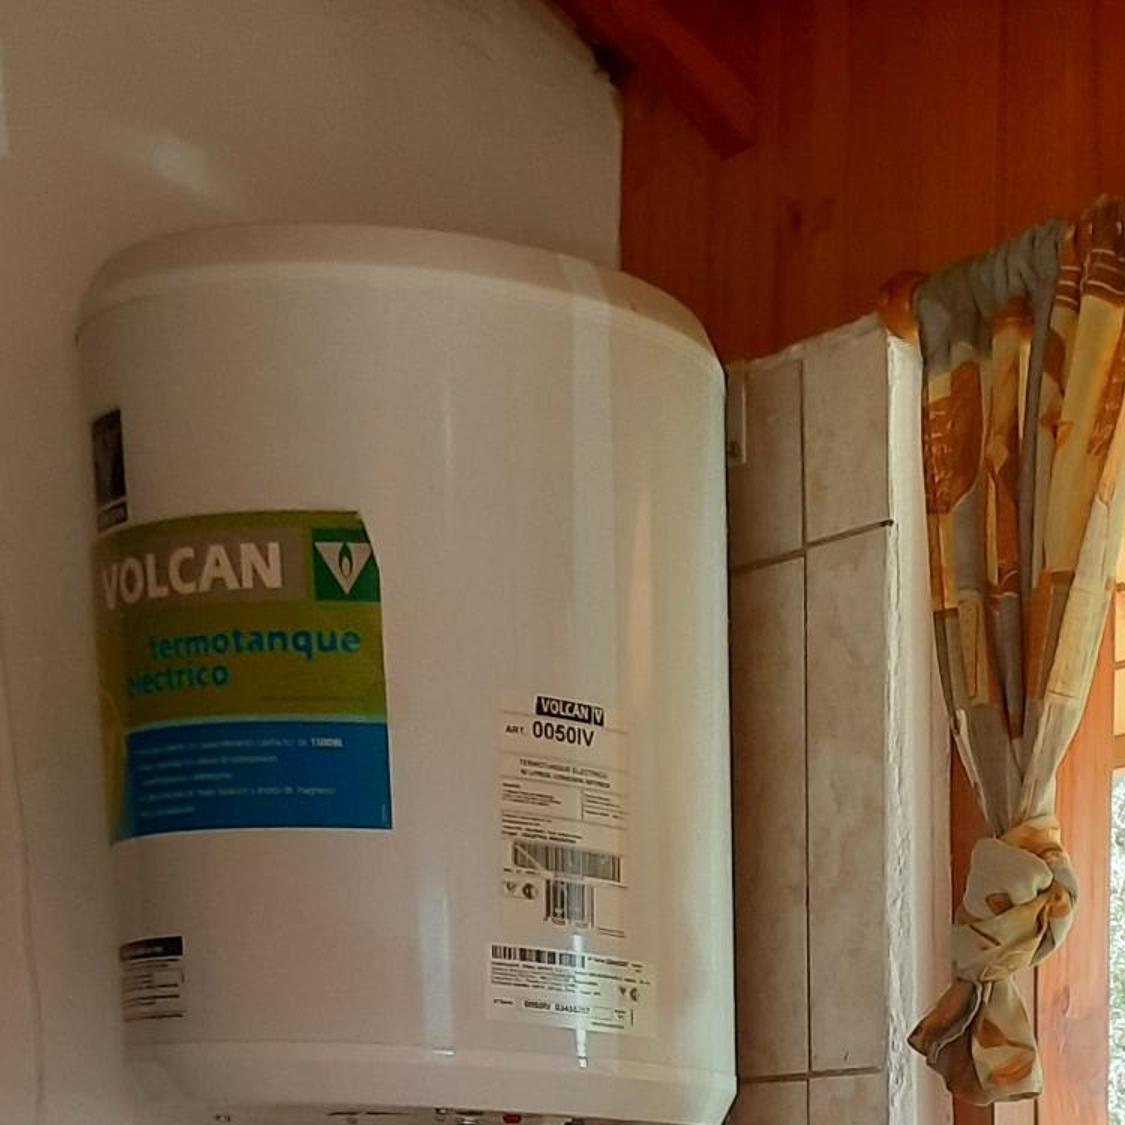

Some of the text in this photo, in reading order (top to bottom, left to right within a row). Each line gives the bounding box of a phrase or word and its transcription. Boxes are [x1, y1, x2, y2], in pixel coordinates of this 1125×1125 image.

[102, 542, 283, 610] VOLCAN
[149, 628, 362, 663] termotanque
[541, 698, 589, 720] VOLCAN
[532, 721, 595, 748] 0050IV
